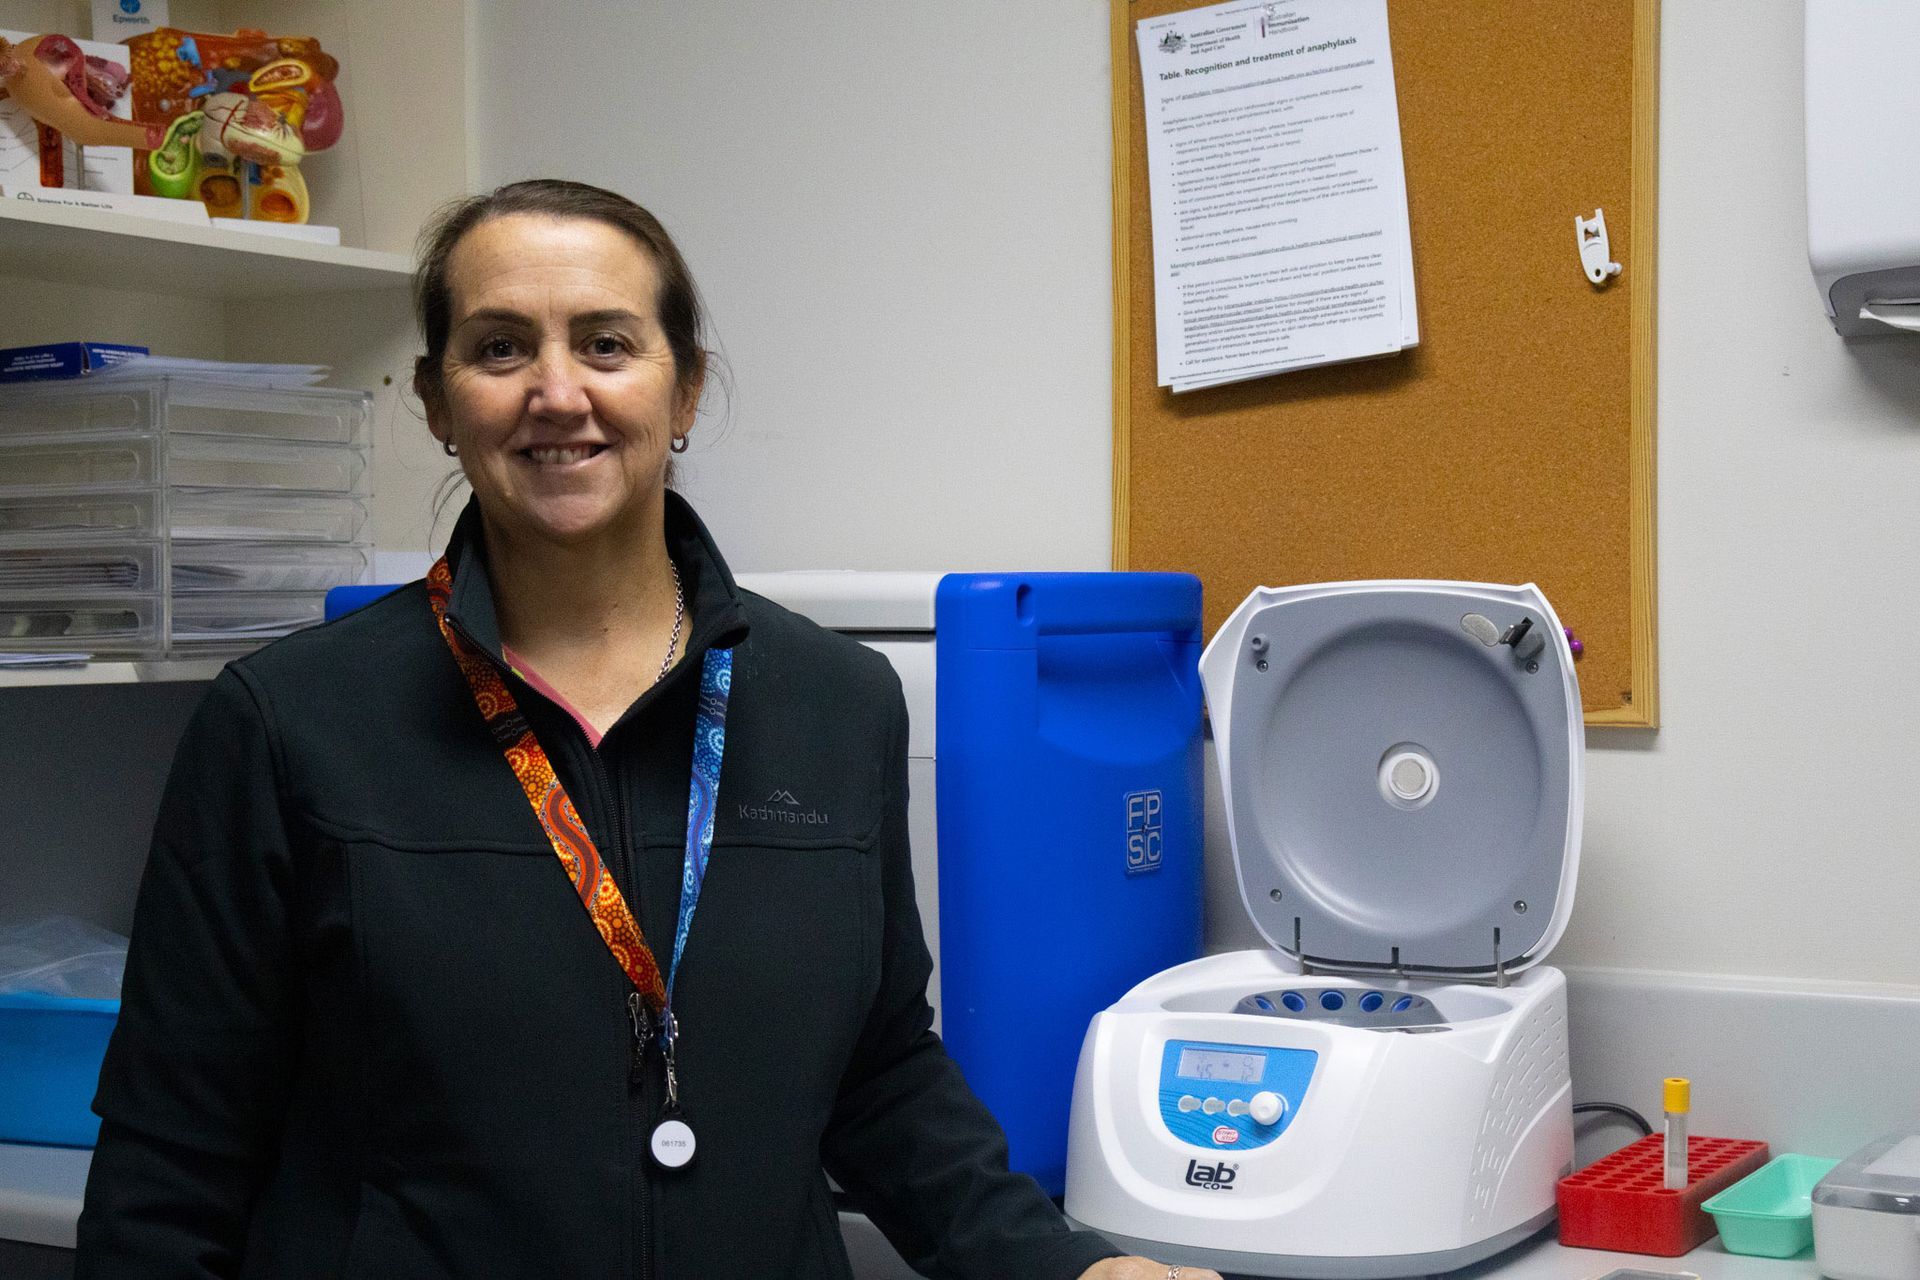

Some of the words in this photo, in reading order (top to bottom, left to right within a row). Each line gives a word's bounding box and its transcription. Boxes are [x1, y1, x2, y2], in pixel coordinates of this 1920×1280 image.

[113, 14, 150, 25] Epworth
[1160, 70, 1182, 81] Table.
[1185, 60, 1233, 78] Recognition
[1235, 56, 1250, 66] and
[1253, 49, 1294, 63] treatment
[1296, 46, 1304, 55] of
[1308, 36, 1356, 54] anaphylaxis
[739, 804, 829, 824] Kathmandu
[1129, 795, 1161, 828] FP
[1129, 832, 1161, 865] SC
